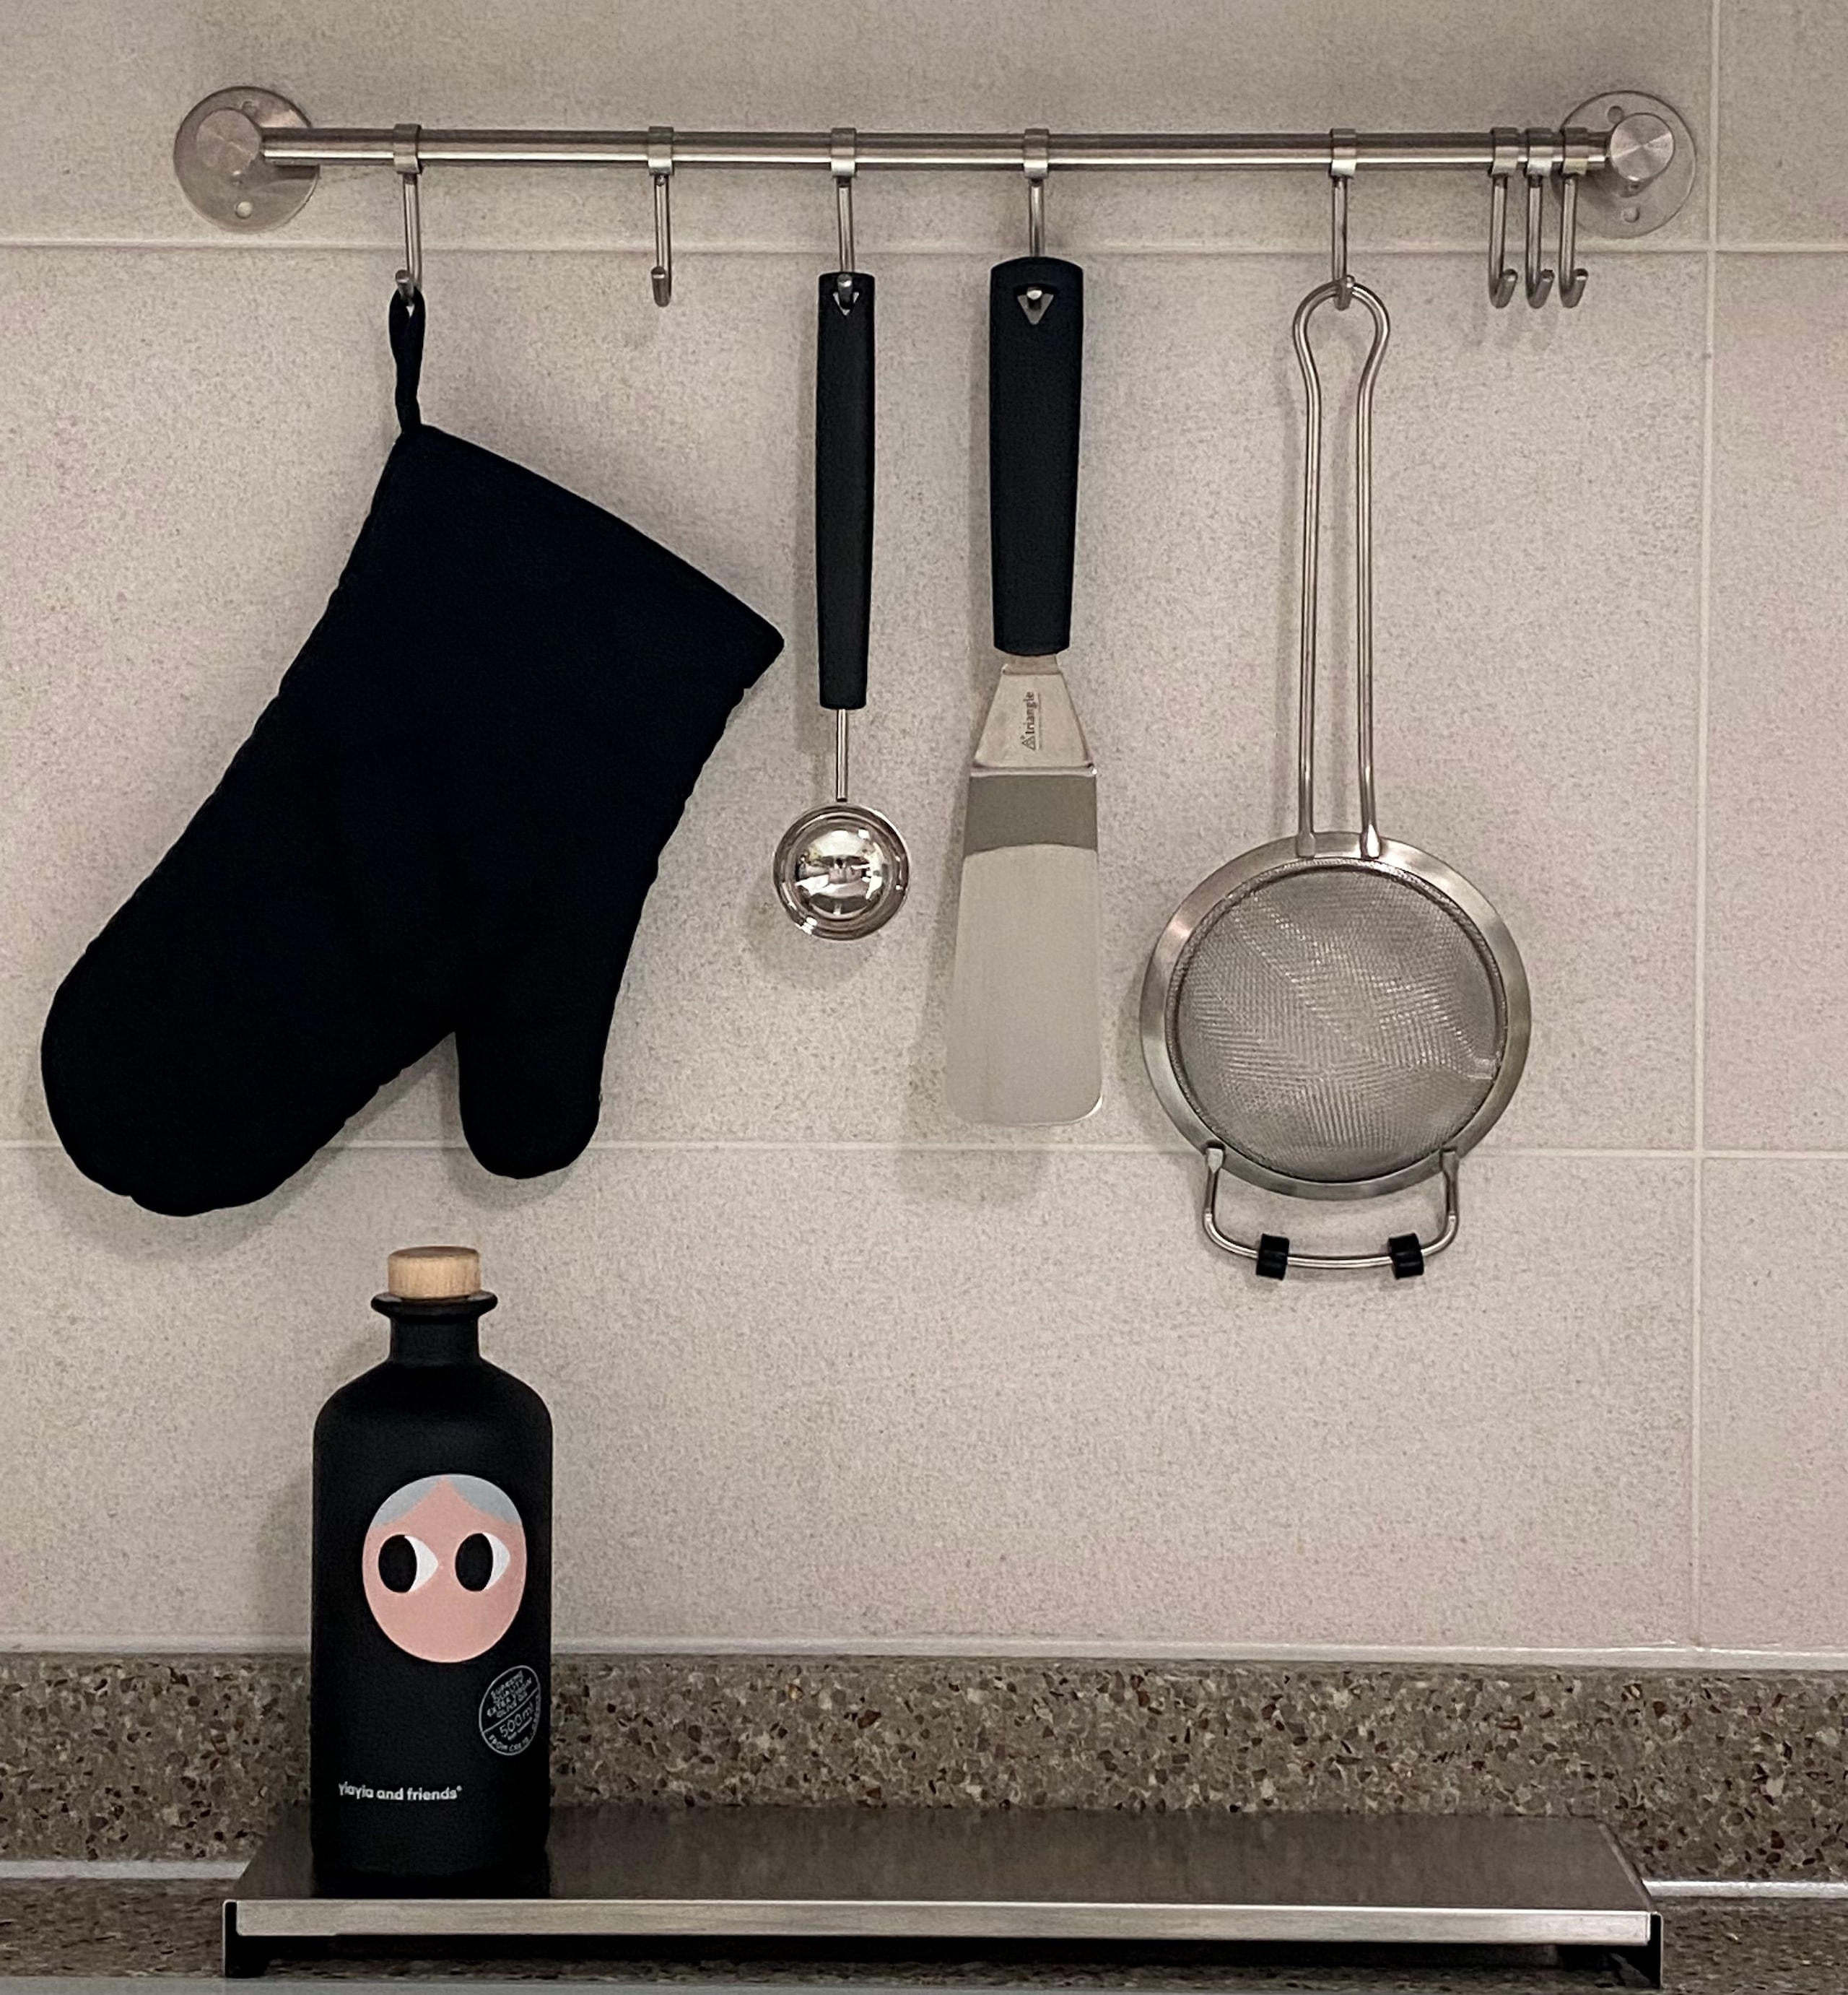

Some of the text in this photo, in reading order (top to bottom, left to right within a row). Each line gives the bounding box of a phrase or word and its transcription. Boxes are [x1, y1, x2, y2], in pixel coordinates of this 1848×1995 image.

[1023, 691, 1037, 734] triangle
[500, 1701, 534, 1738] 500ml
[377, 1787, 404, 1801] and
